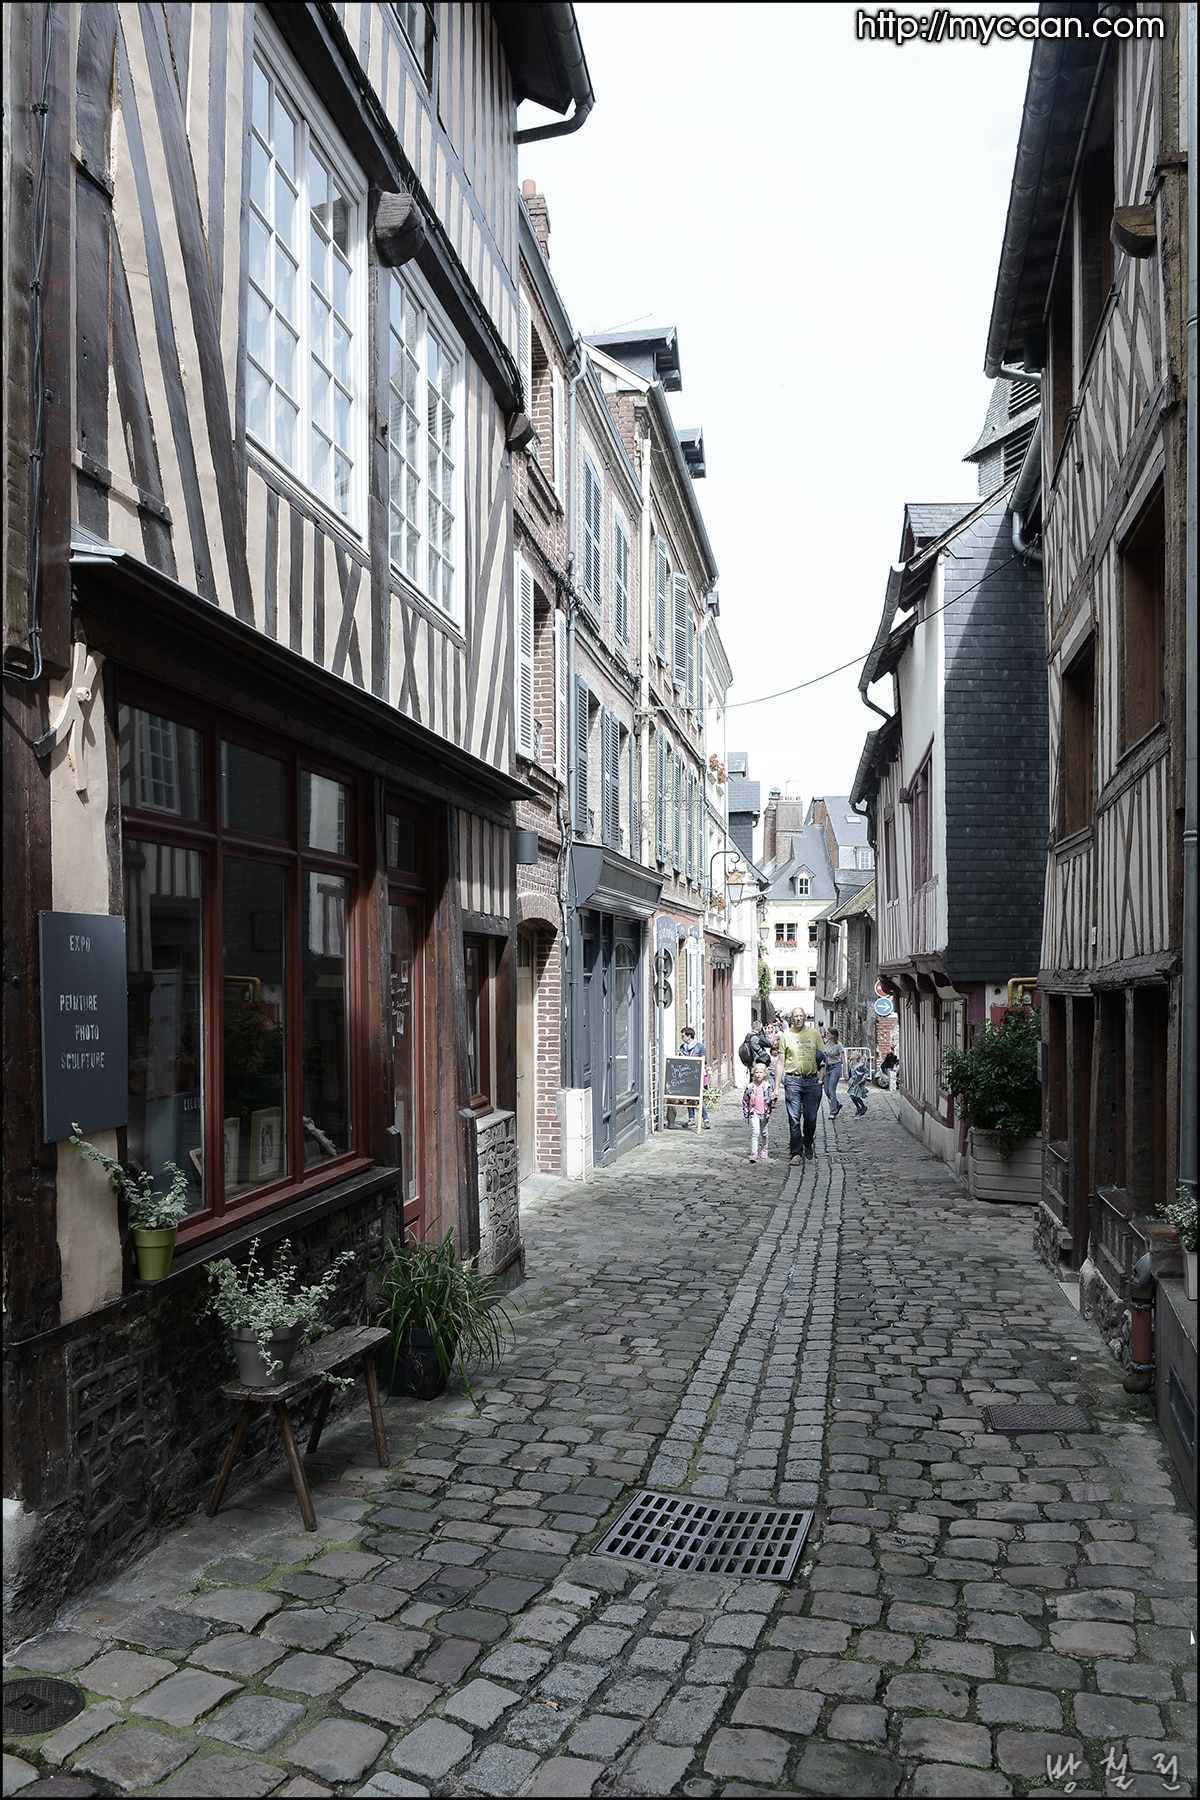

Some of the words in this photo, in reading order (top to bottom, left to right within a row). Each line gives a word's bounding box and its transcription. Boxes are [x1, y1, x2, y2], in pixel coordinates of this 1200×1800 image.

[69, 934, 91, 952] EXPO
[59, 994, 98, 1012] PEINTURE
[75, 1023, 99, 1041] PHOTO
[60, 1051, 105, 1069] SCULPTURE
